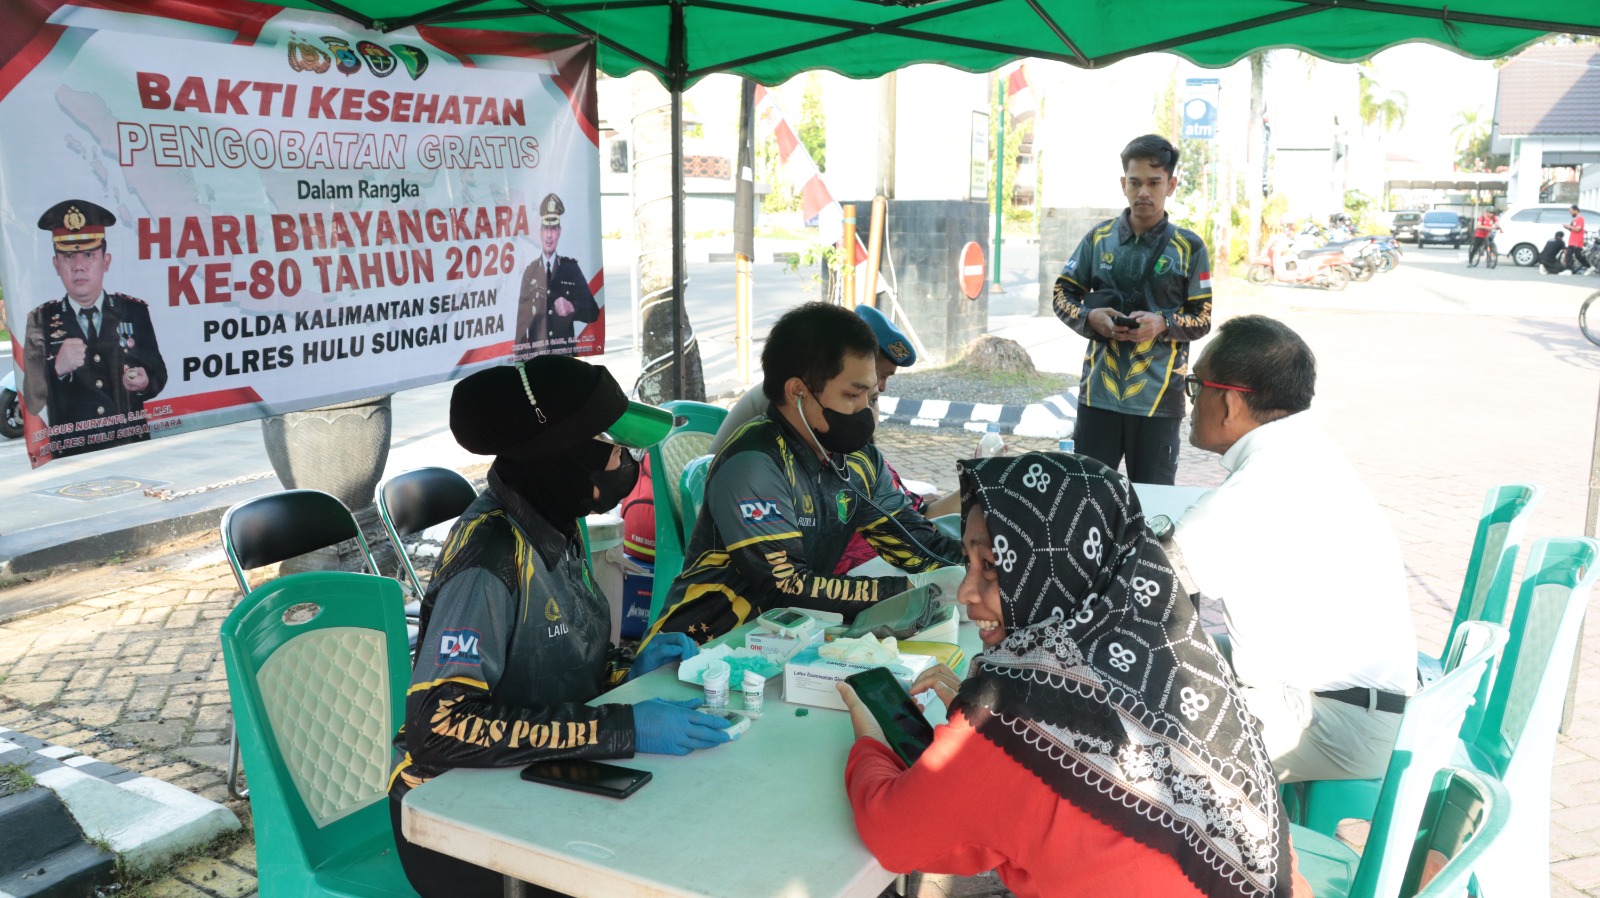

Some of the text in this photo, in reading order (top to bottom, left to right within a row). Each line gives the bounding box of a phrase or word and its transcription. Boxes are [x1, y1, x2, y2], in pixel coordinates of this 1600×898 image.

[136, 71, 526, 126] BAKTI KESEHATAN
[1185, 123, 1212, 135] atm
[117, 122, 540, 170] PENGOBATAN GRATIS
[297, 178, 420, 203] Dalam Rangka
[138, 205, 530, 260] HARI BHAYANGKARA
[168, 242, 515, 307] KE-80 TAHUN 2026
[204, 288, 497, 342] POLDA KALIMANTAN SELATAN
[183, 314, 505, 381] POLRES HULU SUNGAI UTARA
[75, 414, 127, 431] NURYANTO,
[87, 430, 115, 445] HULU
[117, 423, 150, 438] SUNGAI
[153, 418, 182, 432] UTARA
[810, 576, 879, 602] POLRI
[807, 672, 834, 681] Examination
[508, 719, 599, 749] POLRI
